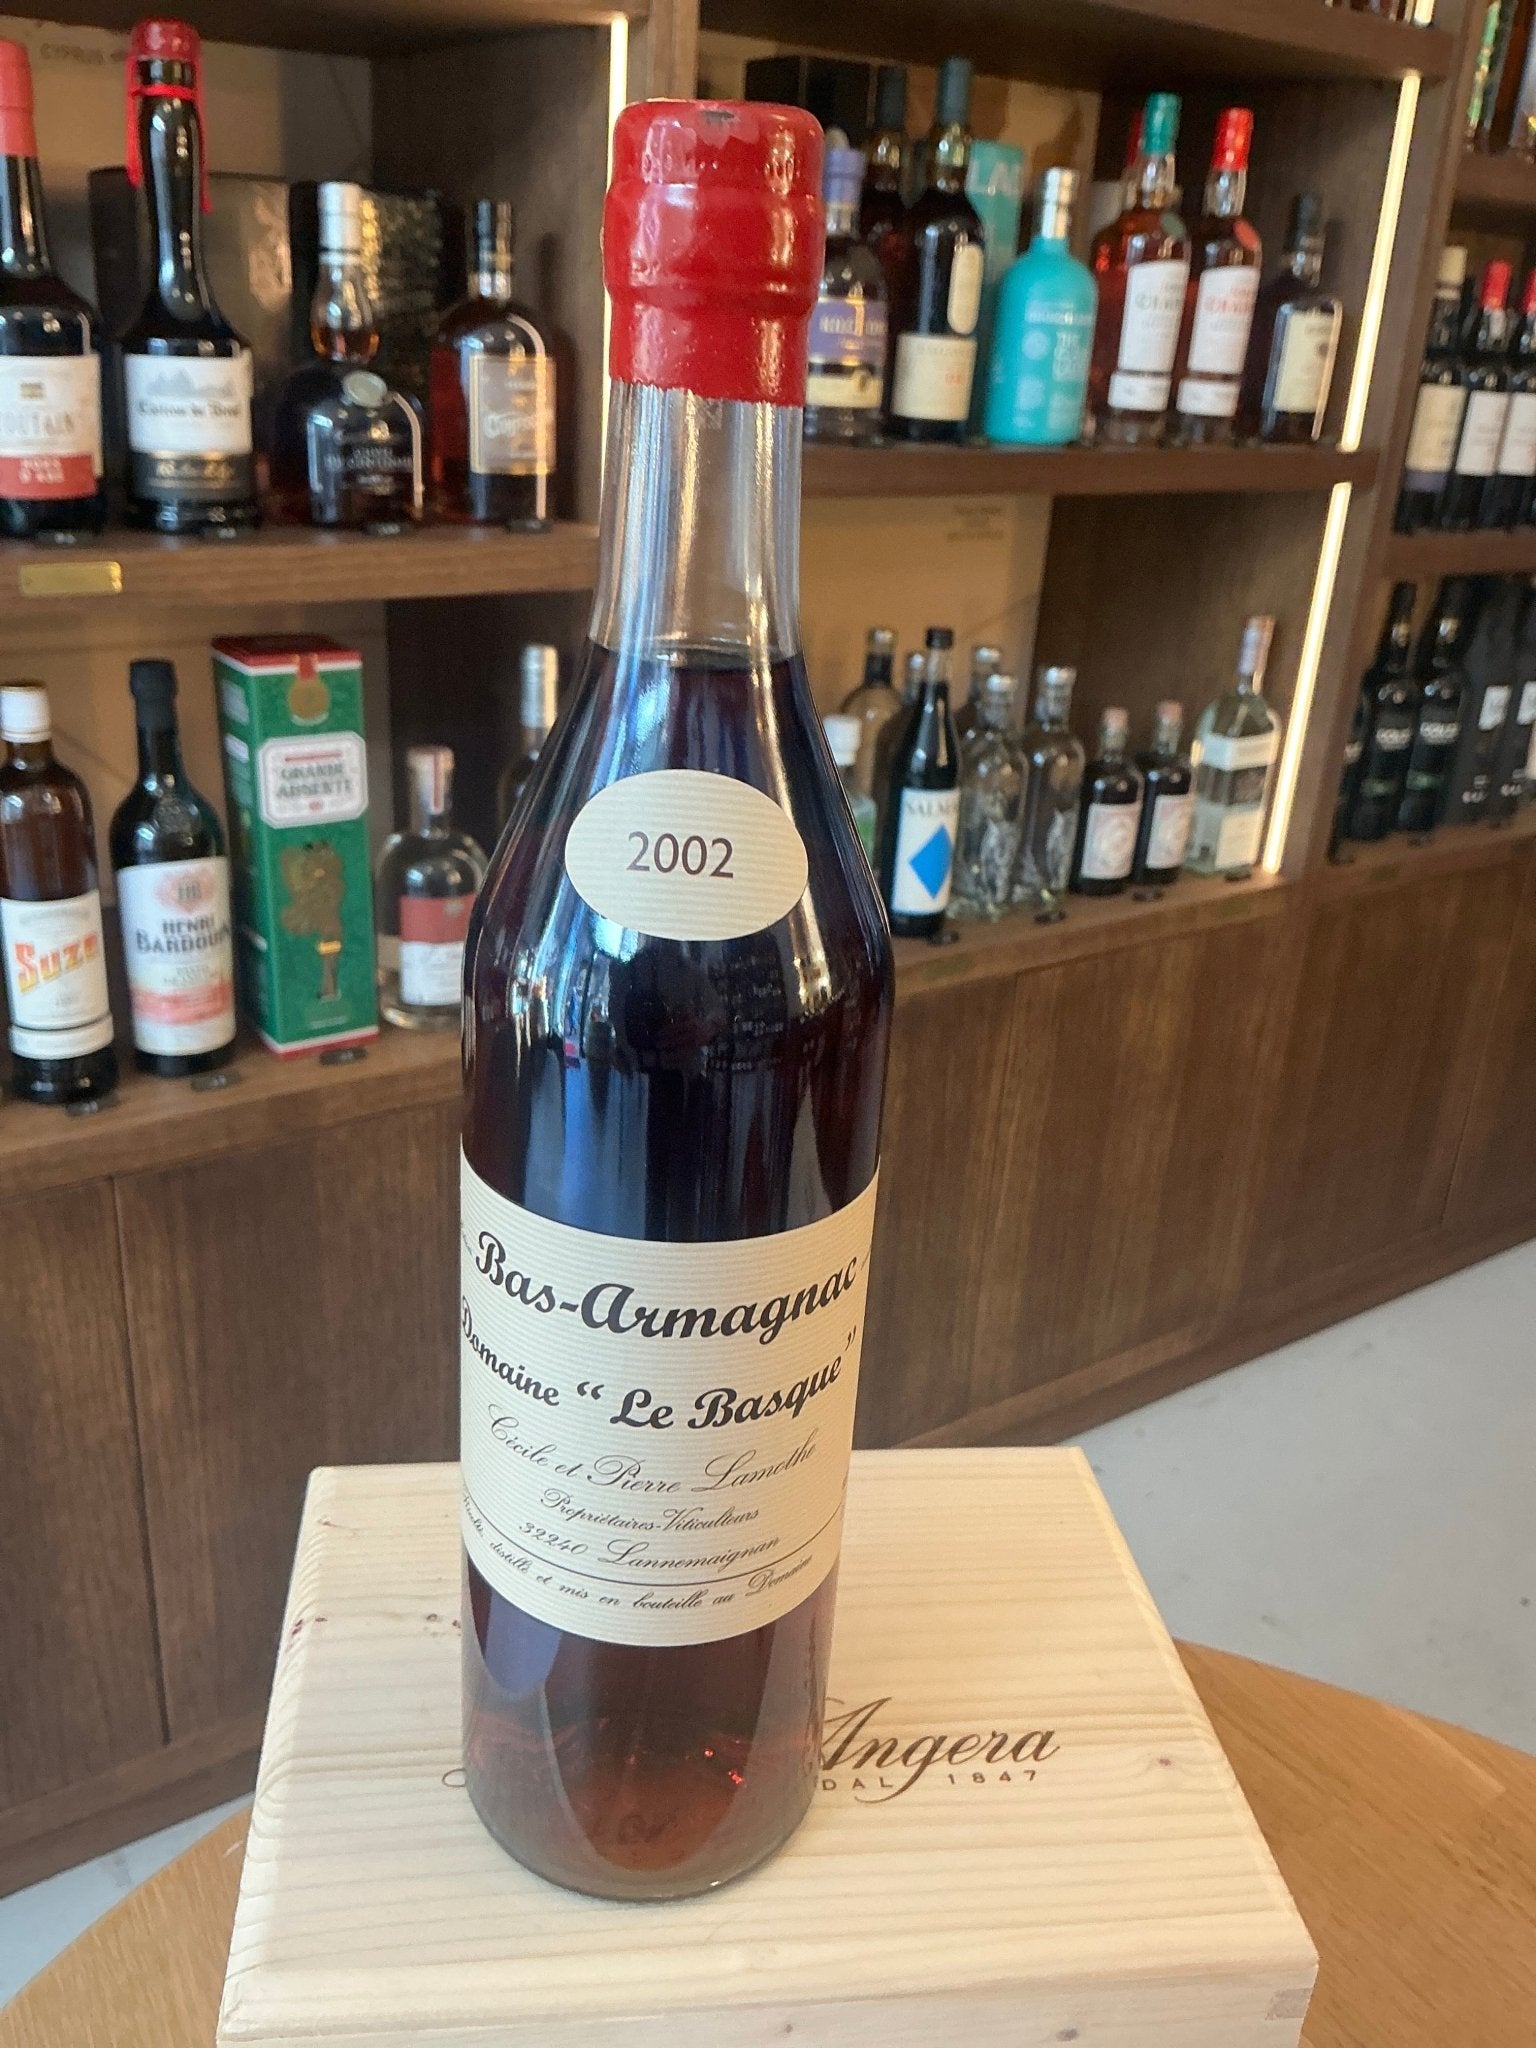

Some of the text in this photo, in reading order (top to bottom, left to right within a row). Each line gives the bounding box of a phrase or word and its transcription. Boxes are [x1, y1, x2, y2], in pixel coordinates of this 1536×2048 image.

[626, 831, 734, 879] 2002
[475, 1230, 858, 1346] Bas-Armagnac
[462, 1295, 560, 1407] Domaine
[488, 1403, 819, 1494] Cécile et Pierre Lamothe
[540, 1487, 760, 1532] Propriétaires-Viticulteurs
[518, 1521, 780, 1573] 32240 Lannemaignan
[536, 1574, 553, 1586] et
[559, 1584, 590, 1599] mis
[599, 1595, 621, 1607] en
[632, 1589, 709, 1610] bouteille
[712, 1592, 736, 1606] au
[744, 1554, 813, 1597] Domaine
[822, 1769, 1037, 1792] DAL 1847
